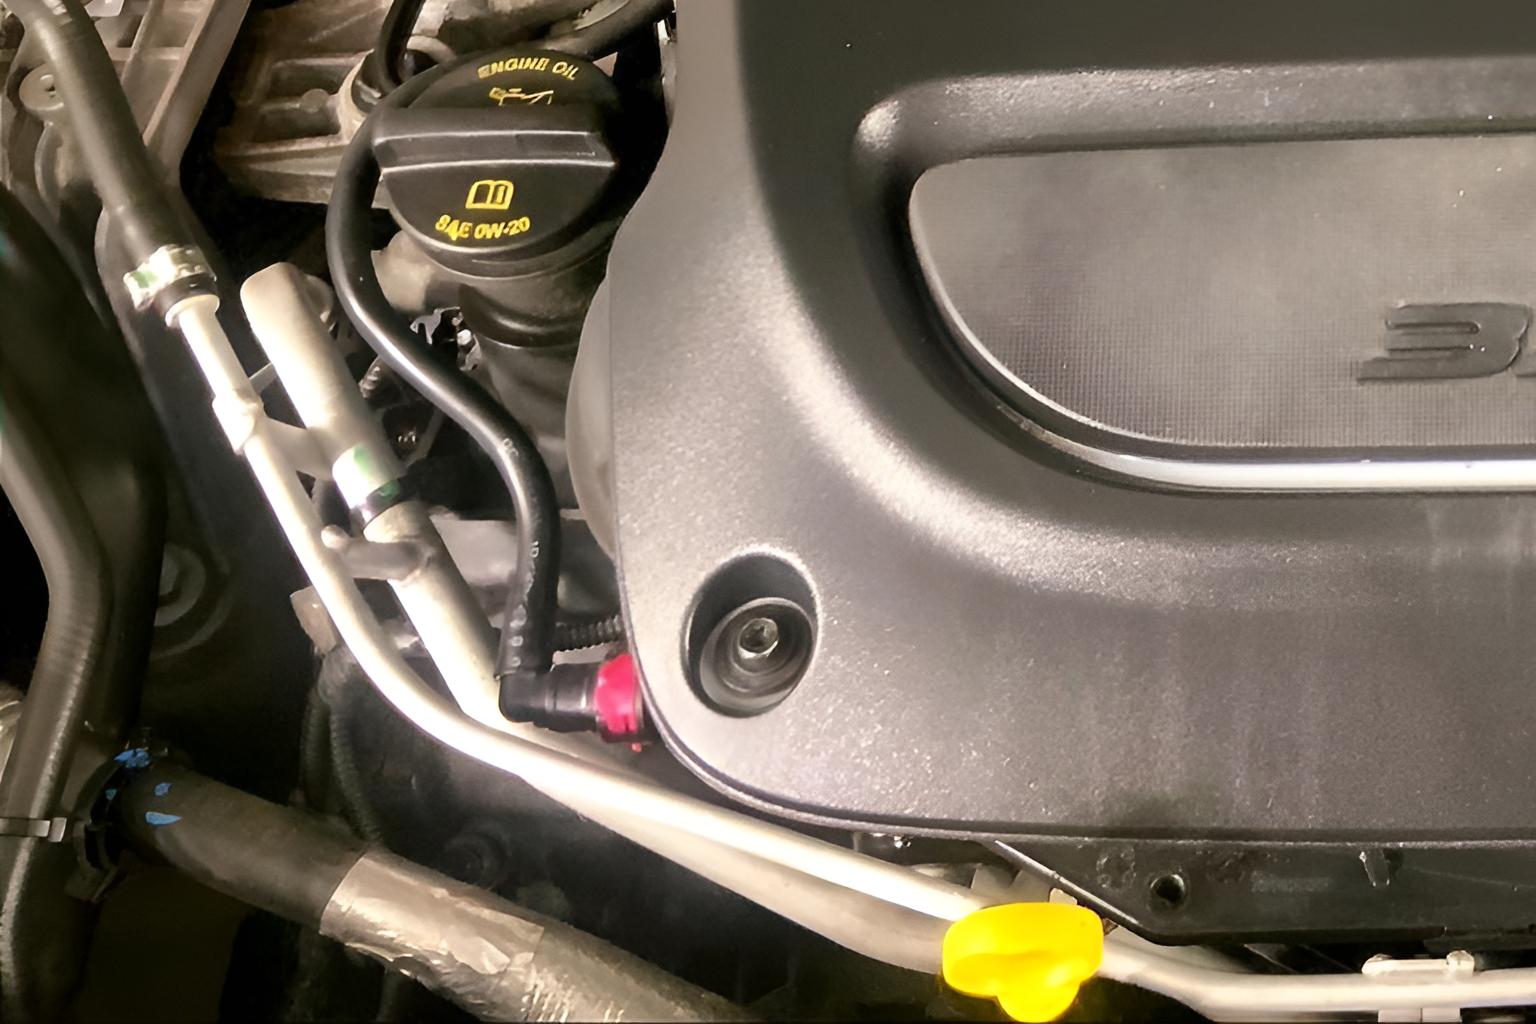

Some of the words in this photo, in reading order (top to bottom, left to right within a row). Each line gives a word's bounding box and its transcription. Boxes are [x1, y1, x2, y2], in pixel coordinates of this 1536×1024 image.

[478, 57, 550, 78] ENGINE
[552, 61, 579, 80] OIL
[435, 214, 473, 241] SAE
[474, 216, 531, 239] 0W-20
